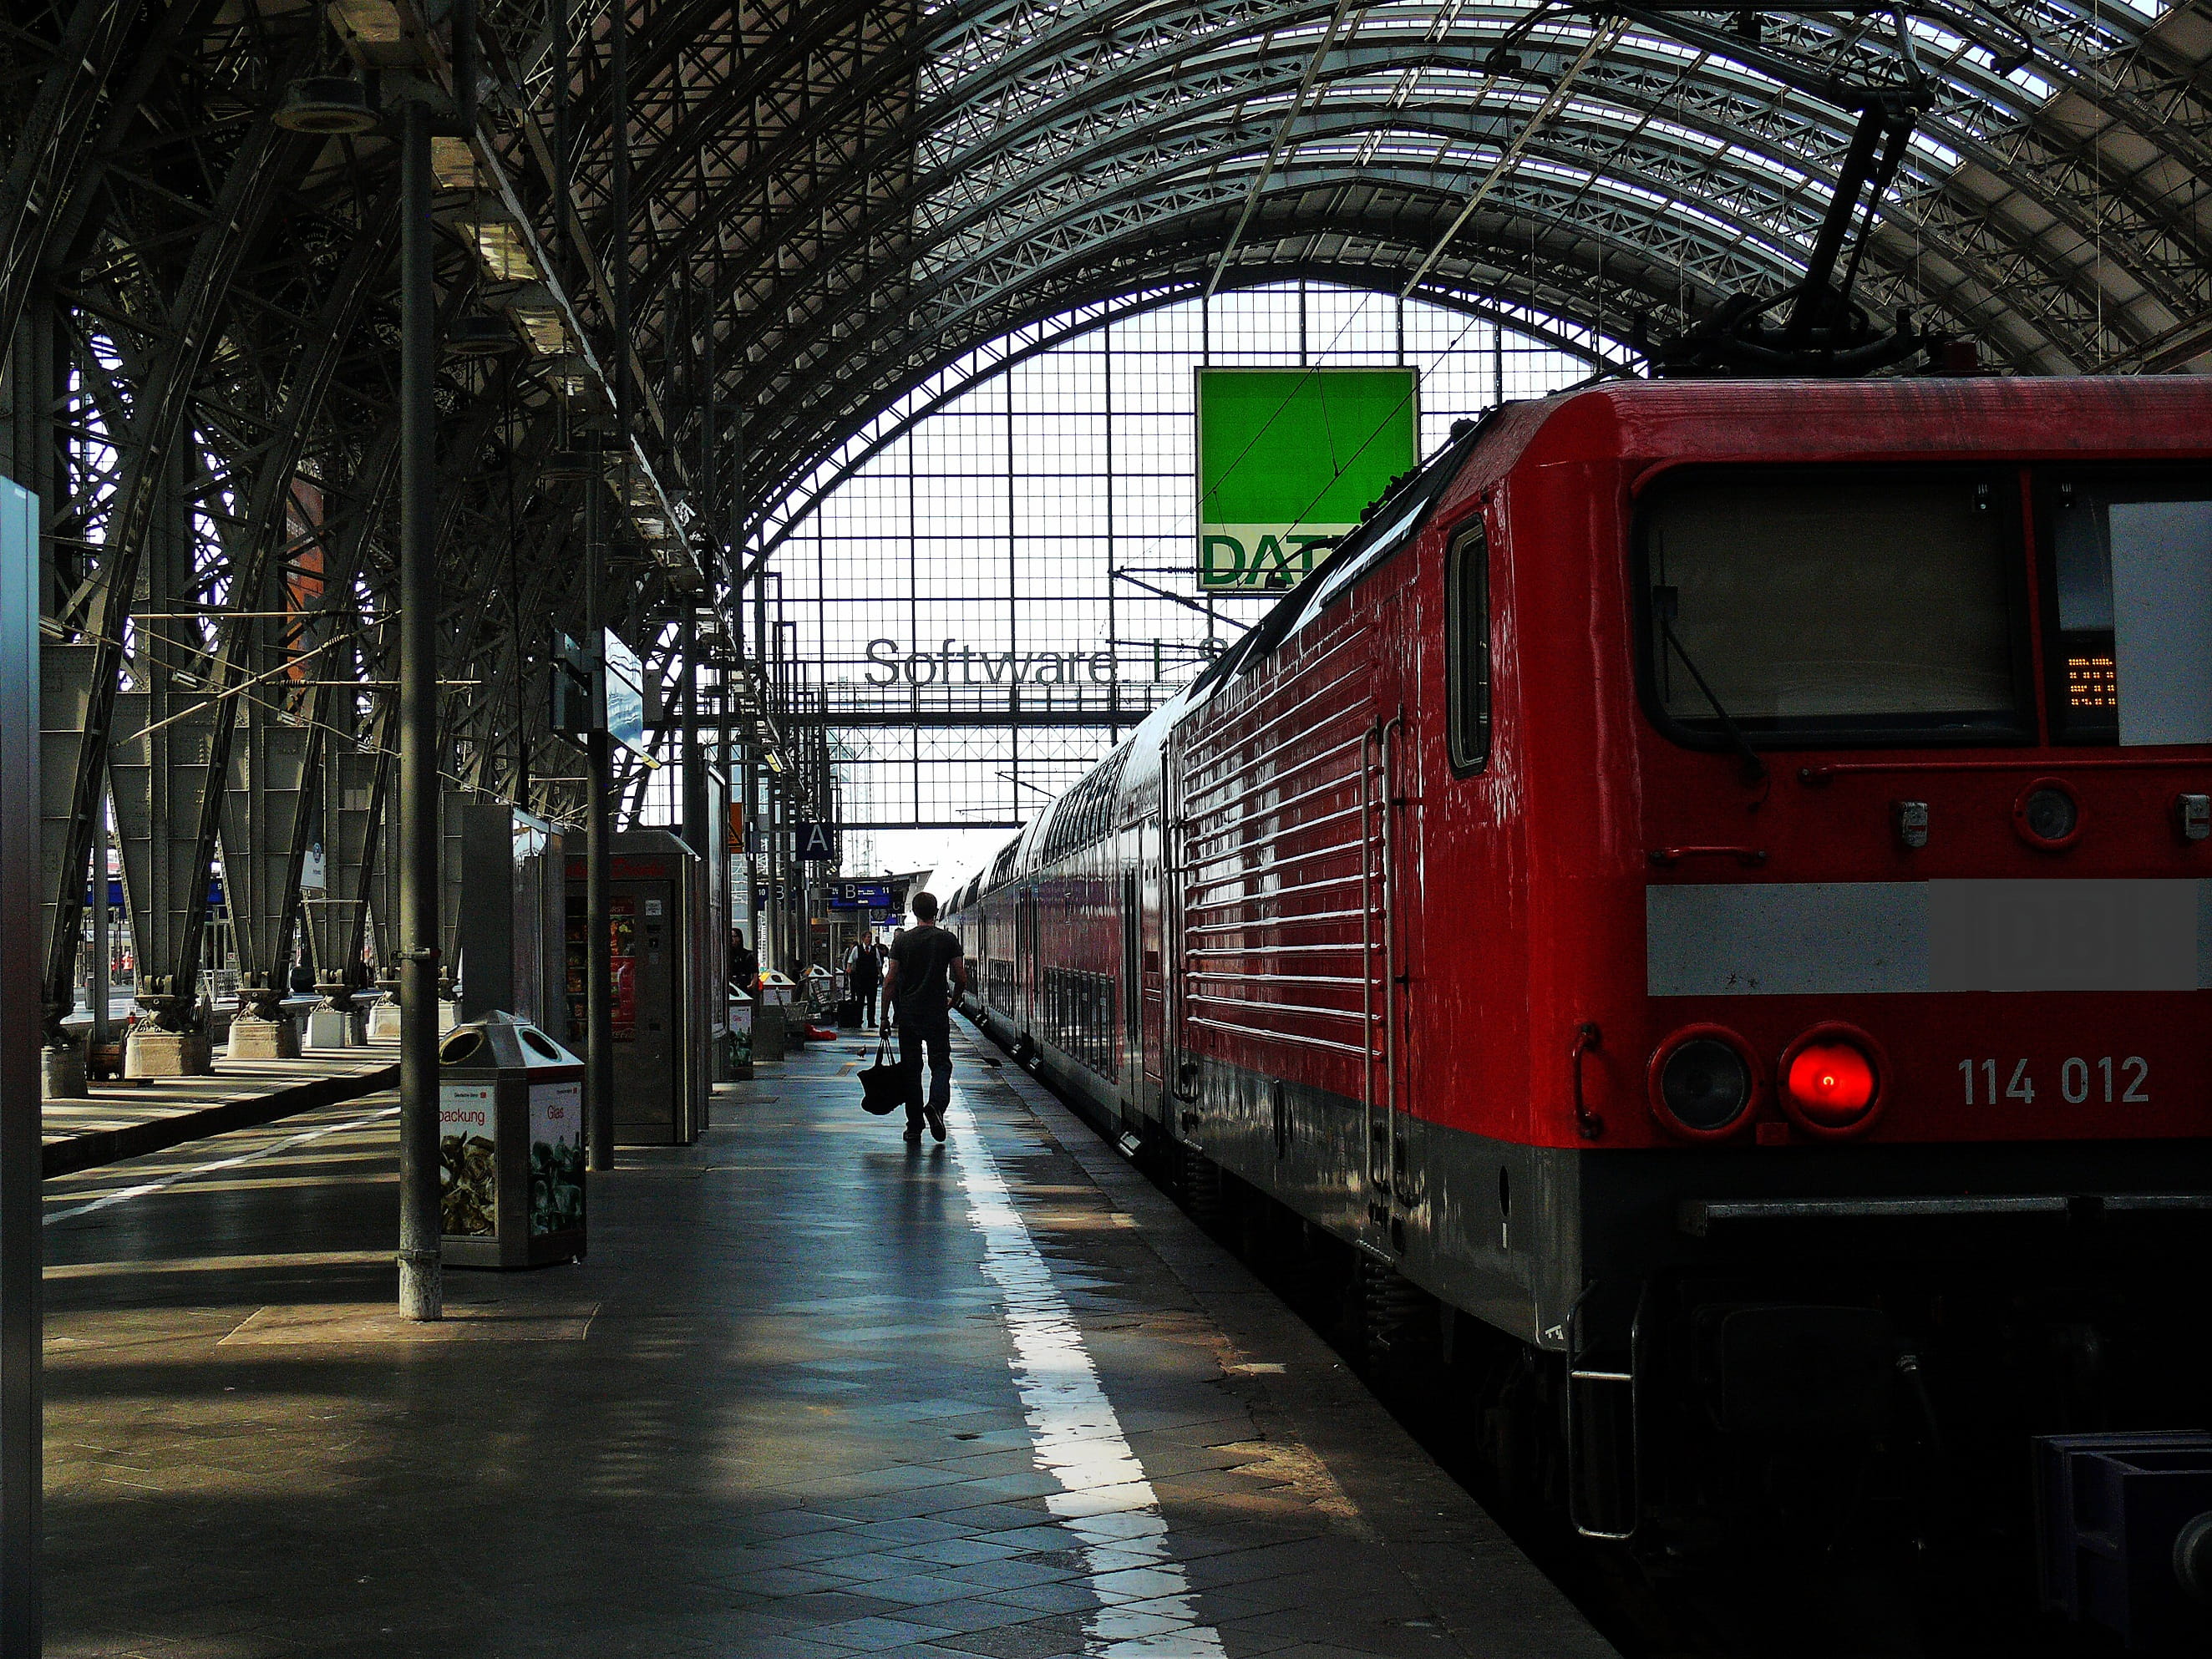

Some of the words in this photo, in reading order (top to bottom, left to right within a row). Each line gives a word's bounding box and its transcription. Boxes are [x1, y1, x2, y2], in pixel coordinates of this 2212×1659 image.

[865, 637, 1119, 687] Software
[806, 824, 829, 851] A
[758, 888, 766, 896] 10
[845, 884, 856, 899] B
[1959, 1058, 2036, 1105] 114
[2061, 1056, 2149, 1104] 012
